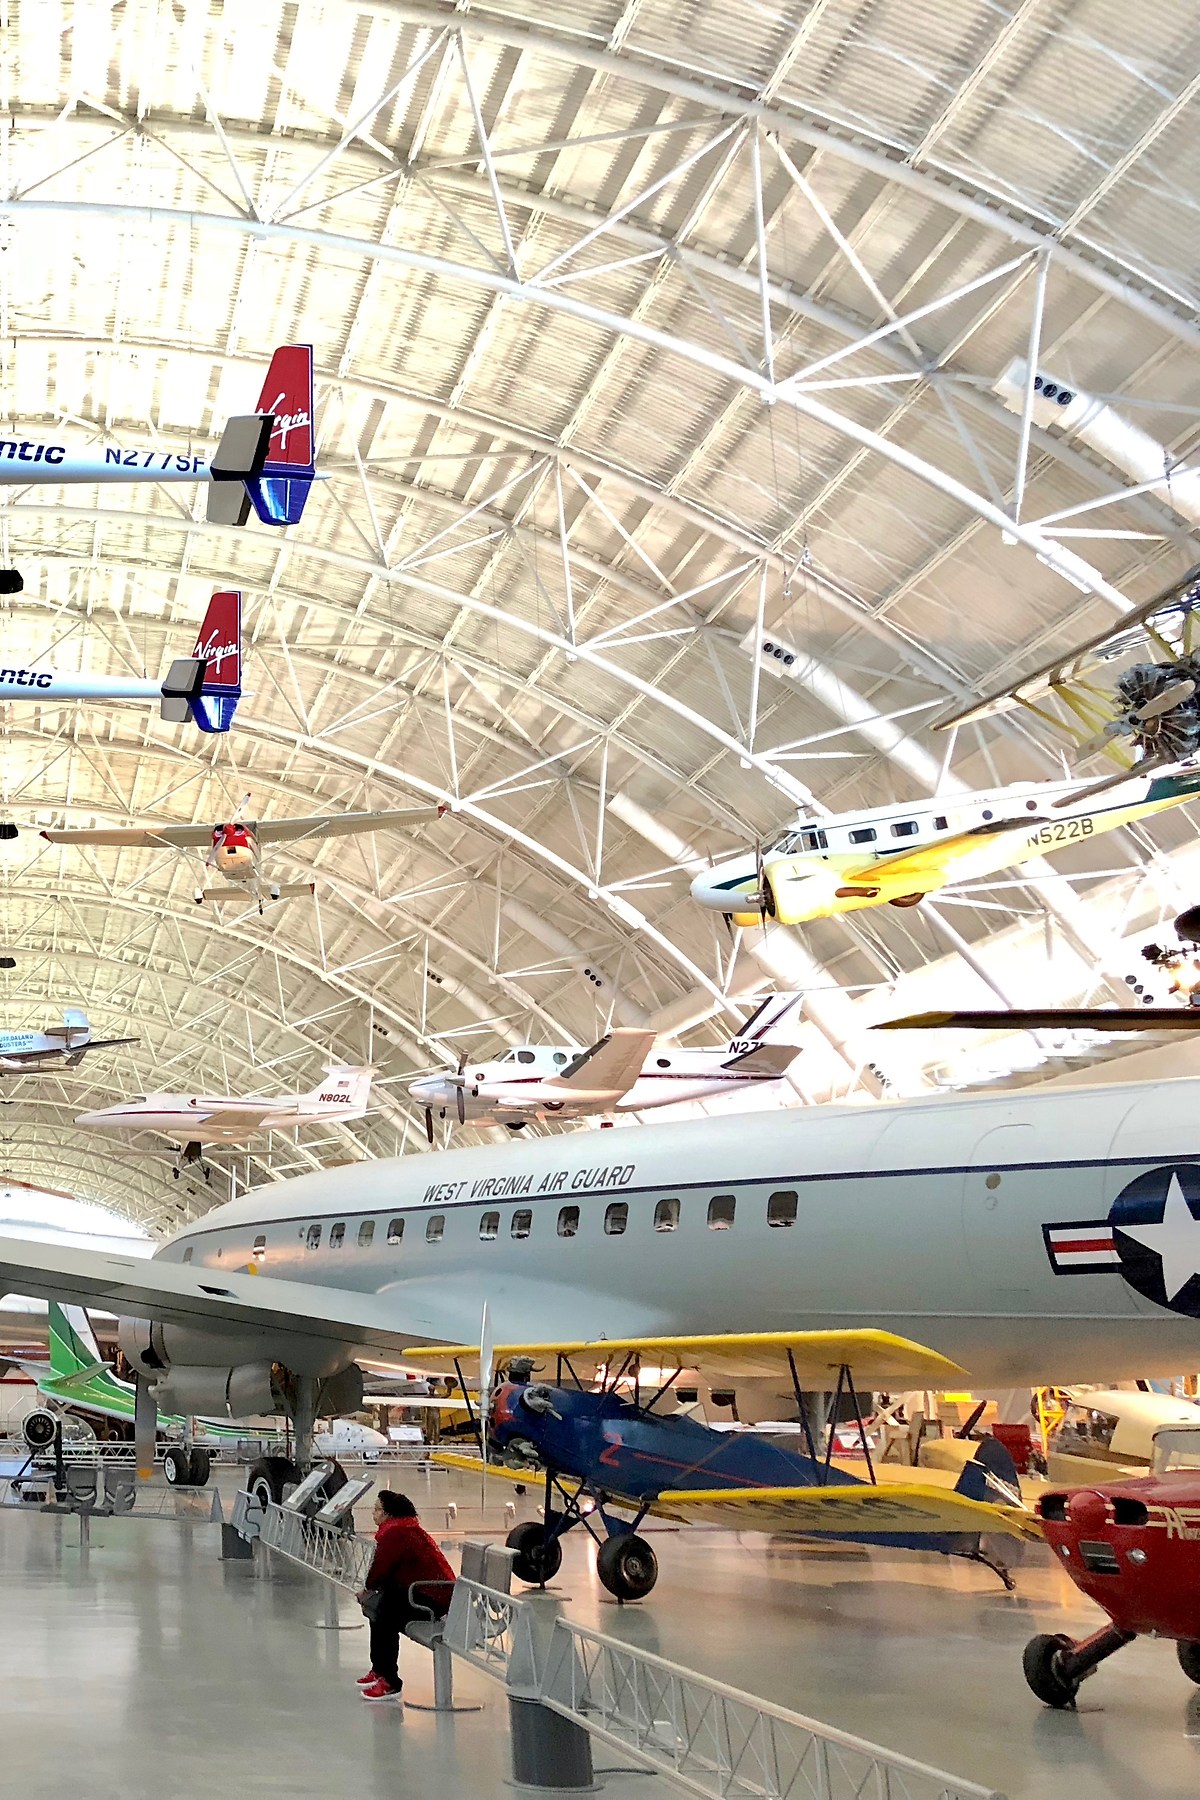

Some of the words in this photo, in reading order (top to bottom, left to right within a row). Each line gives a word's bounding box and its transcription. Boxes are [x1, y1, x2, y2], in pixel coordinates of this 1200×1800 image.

[105, 448, 205, 474] N277SF
[194, 629, 239, 674] Virgin
[1026, 818, 1094, 847] N522B
[728, 1041, 764, 1053] N27
[319, 1093, 352, 1103] N802L
[422, 1181, 468, 1203] WEST
[470, 1174, 534, 1198] VIRGINIA
[537, 1171, 569, 1193] AIR
[571, 1164, 636, 1189] GUARD
[599, 1431, 624, 1468] 2
